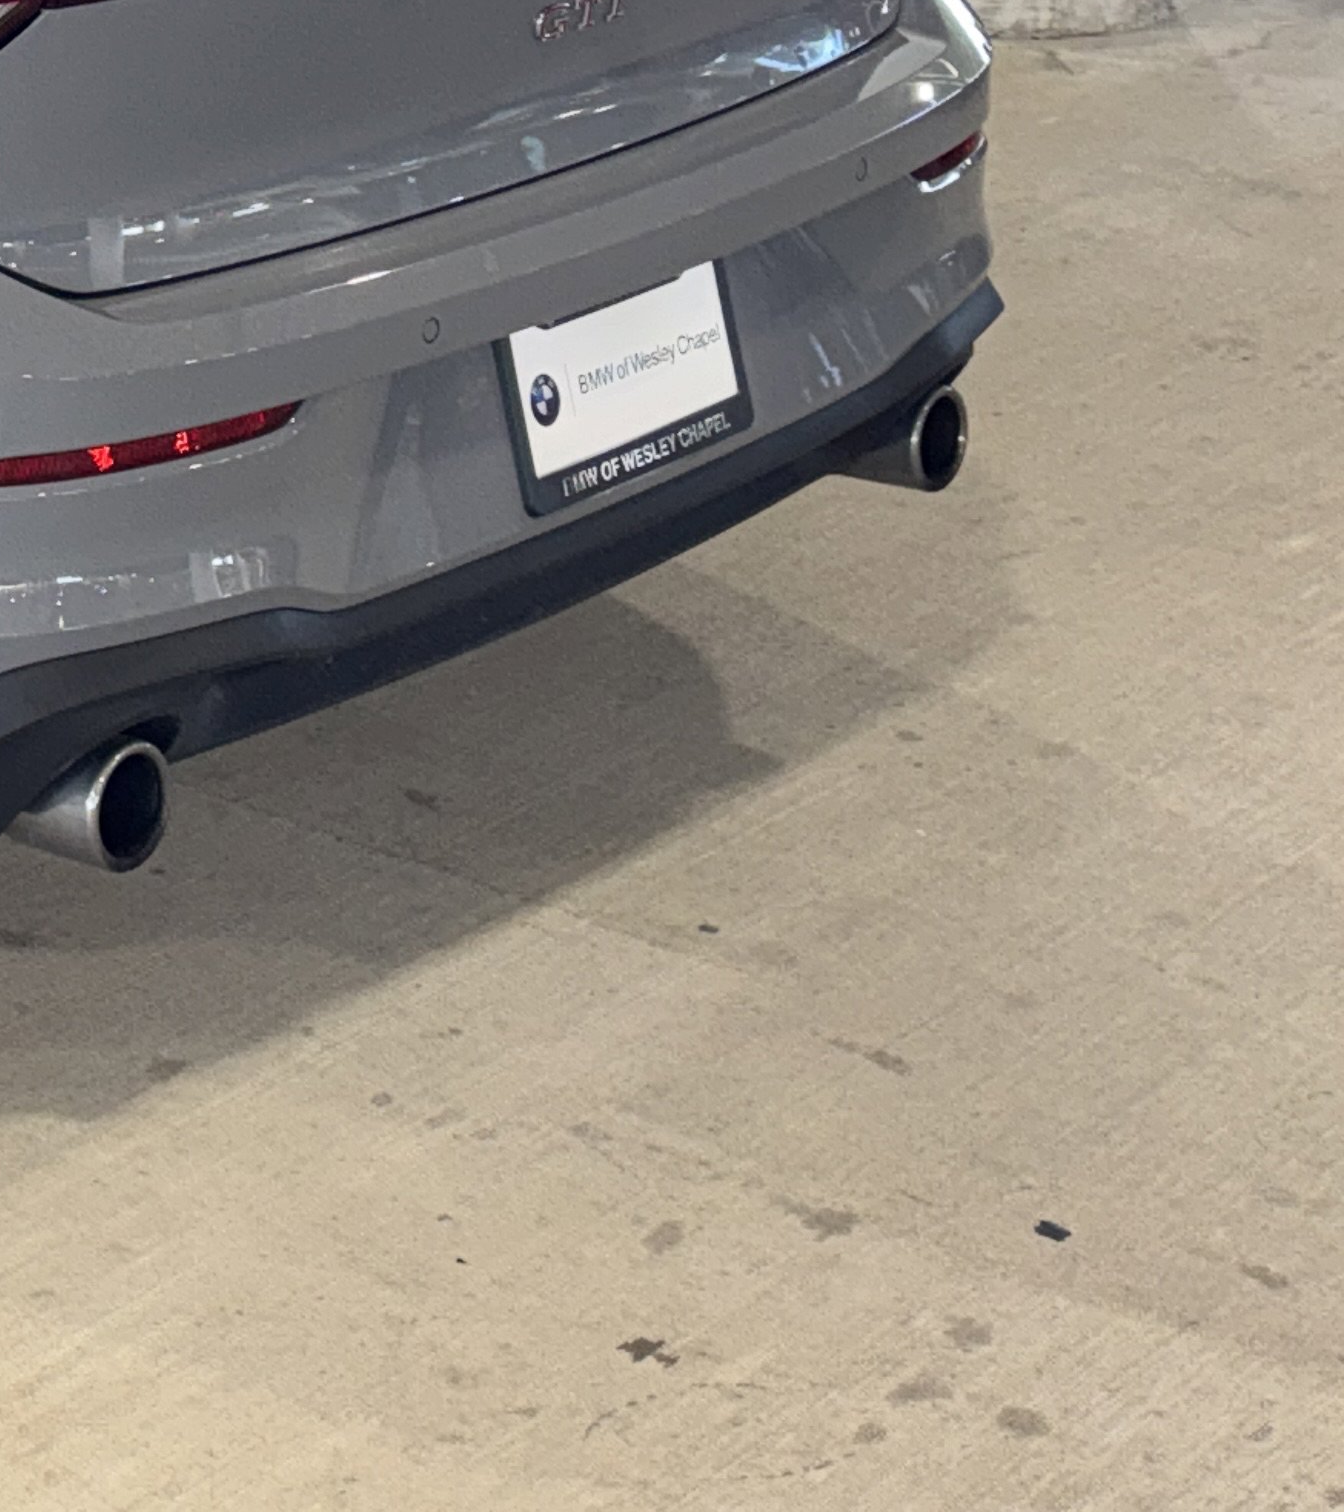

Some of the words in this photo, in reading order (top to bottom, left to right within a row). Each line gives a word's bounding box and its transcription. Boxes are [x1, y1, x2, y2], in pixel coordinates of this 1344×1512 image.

[578, 362, 613, 394] BMW
[616, 358, 631, 379] of
[629, 342, 675, 374] Wesley
[676, 322, 721, 355] Chapel
[600, 456, 620, 482] OF
[620, 432, 676, 473] WESLEY
[676, 411, 732, 448] CHAPEL
